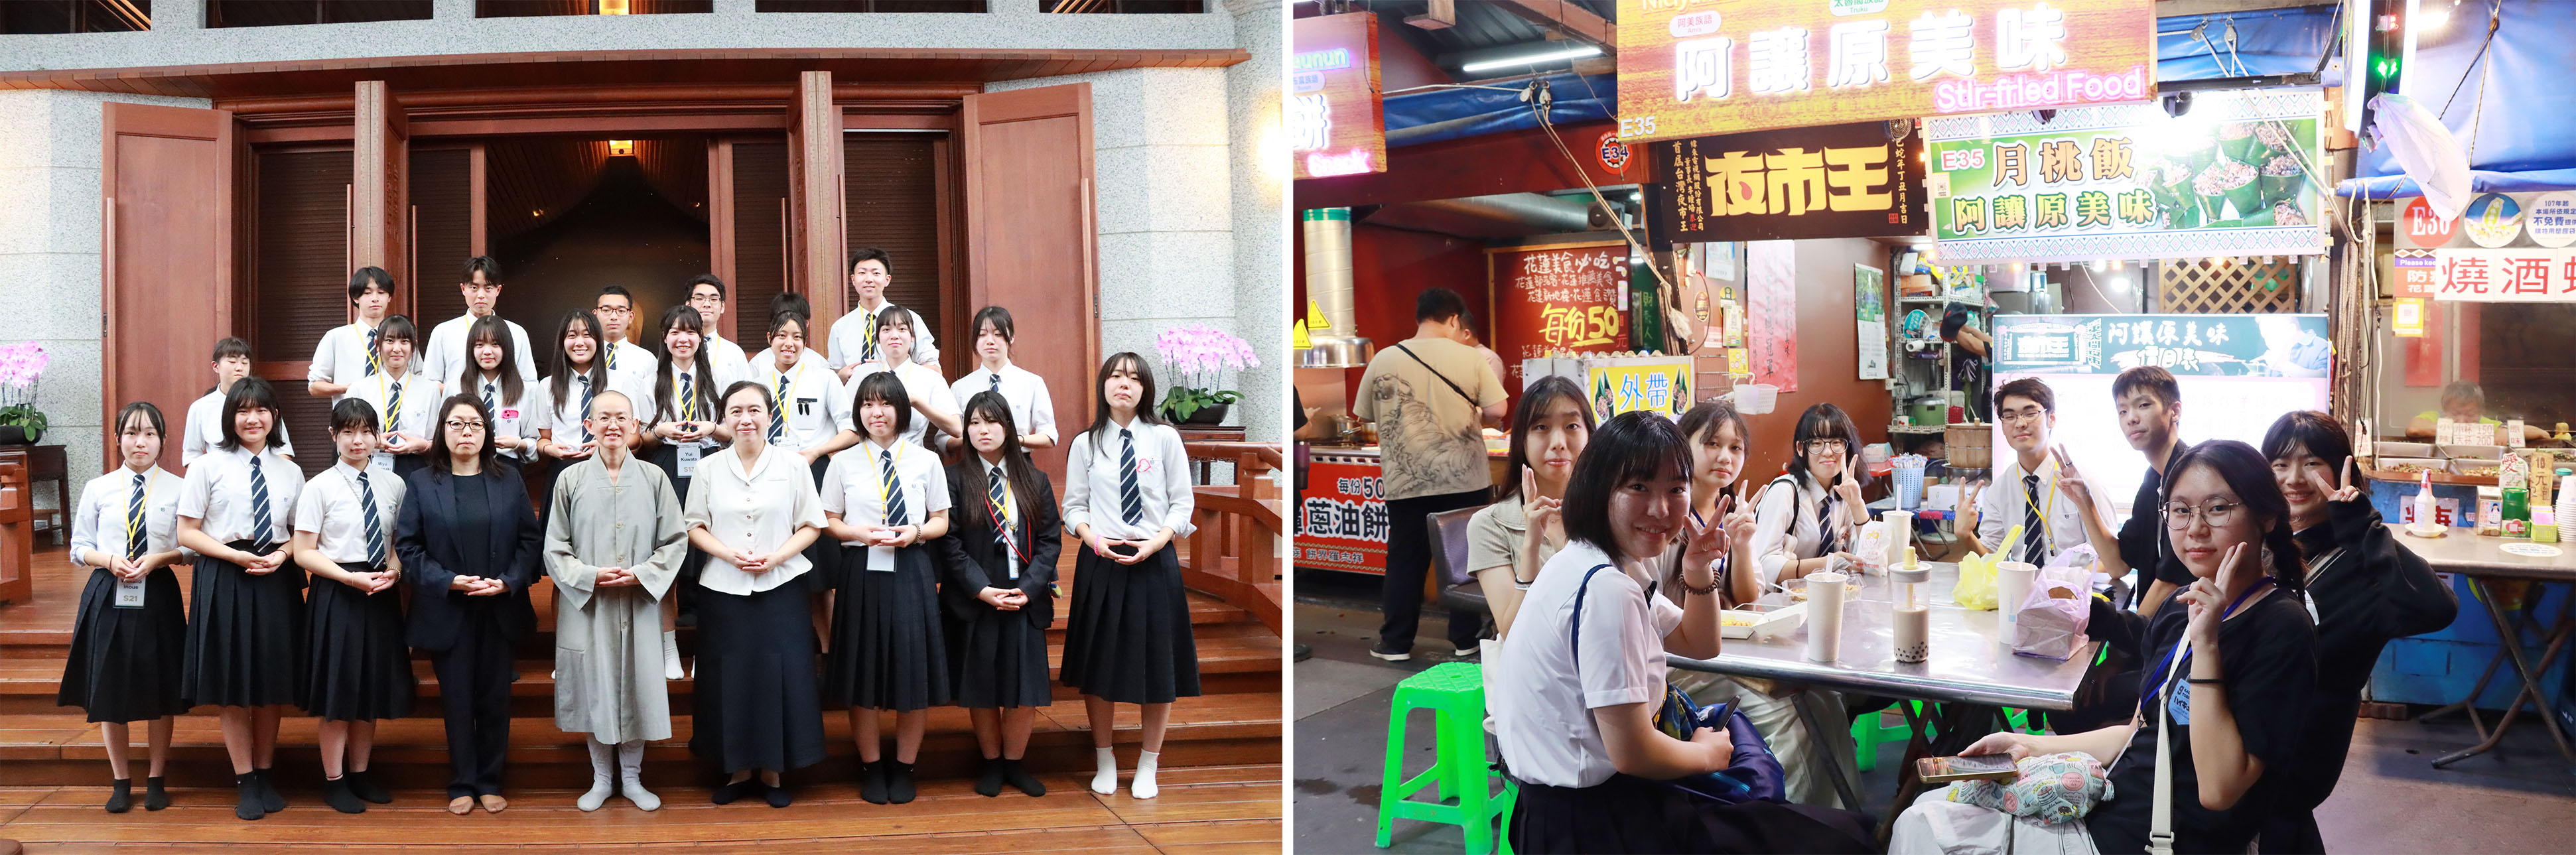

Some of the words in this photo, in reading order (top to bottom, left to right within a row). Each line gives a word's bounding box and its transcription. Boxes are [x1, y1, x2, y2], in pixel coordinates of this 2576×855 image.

[1677, 15, 1712, 28] 阿美族語
[1674, 5, 2066, 101] 阿讓原美味
[2067, 66, 2141, 99] Food
[1621, 116, 1657, 138] E35
[1601, 146, 1629, 159] E34
[1942, 151, 1985, 168] E35
[1993, 137, 2134, 187] 月桃飯
[1704, 143, 1892, 216] 夜市王
[1953, 188, 2155, 232] 阿讓原美味
[1524, 251, 1610, 275] 花蓮美食必吃
[2108, 320, 2230, 346] 阿讓原美味
[1619, 373, 1668, 410] 外帶
[2477, 425, 2493, 435] 150
[2477, 436, 2492, 446] 200
[1338, 477, 1385, 499] 每份50
[1294, 499, 1389, 541] 蔥油餅
